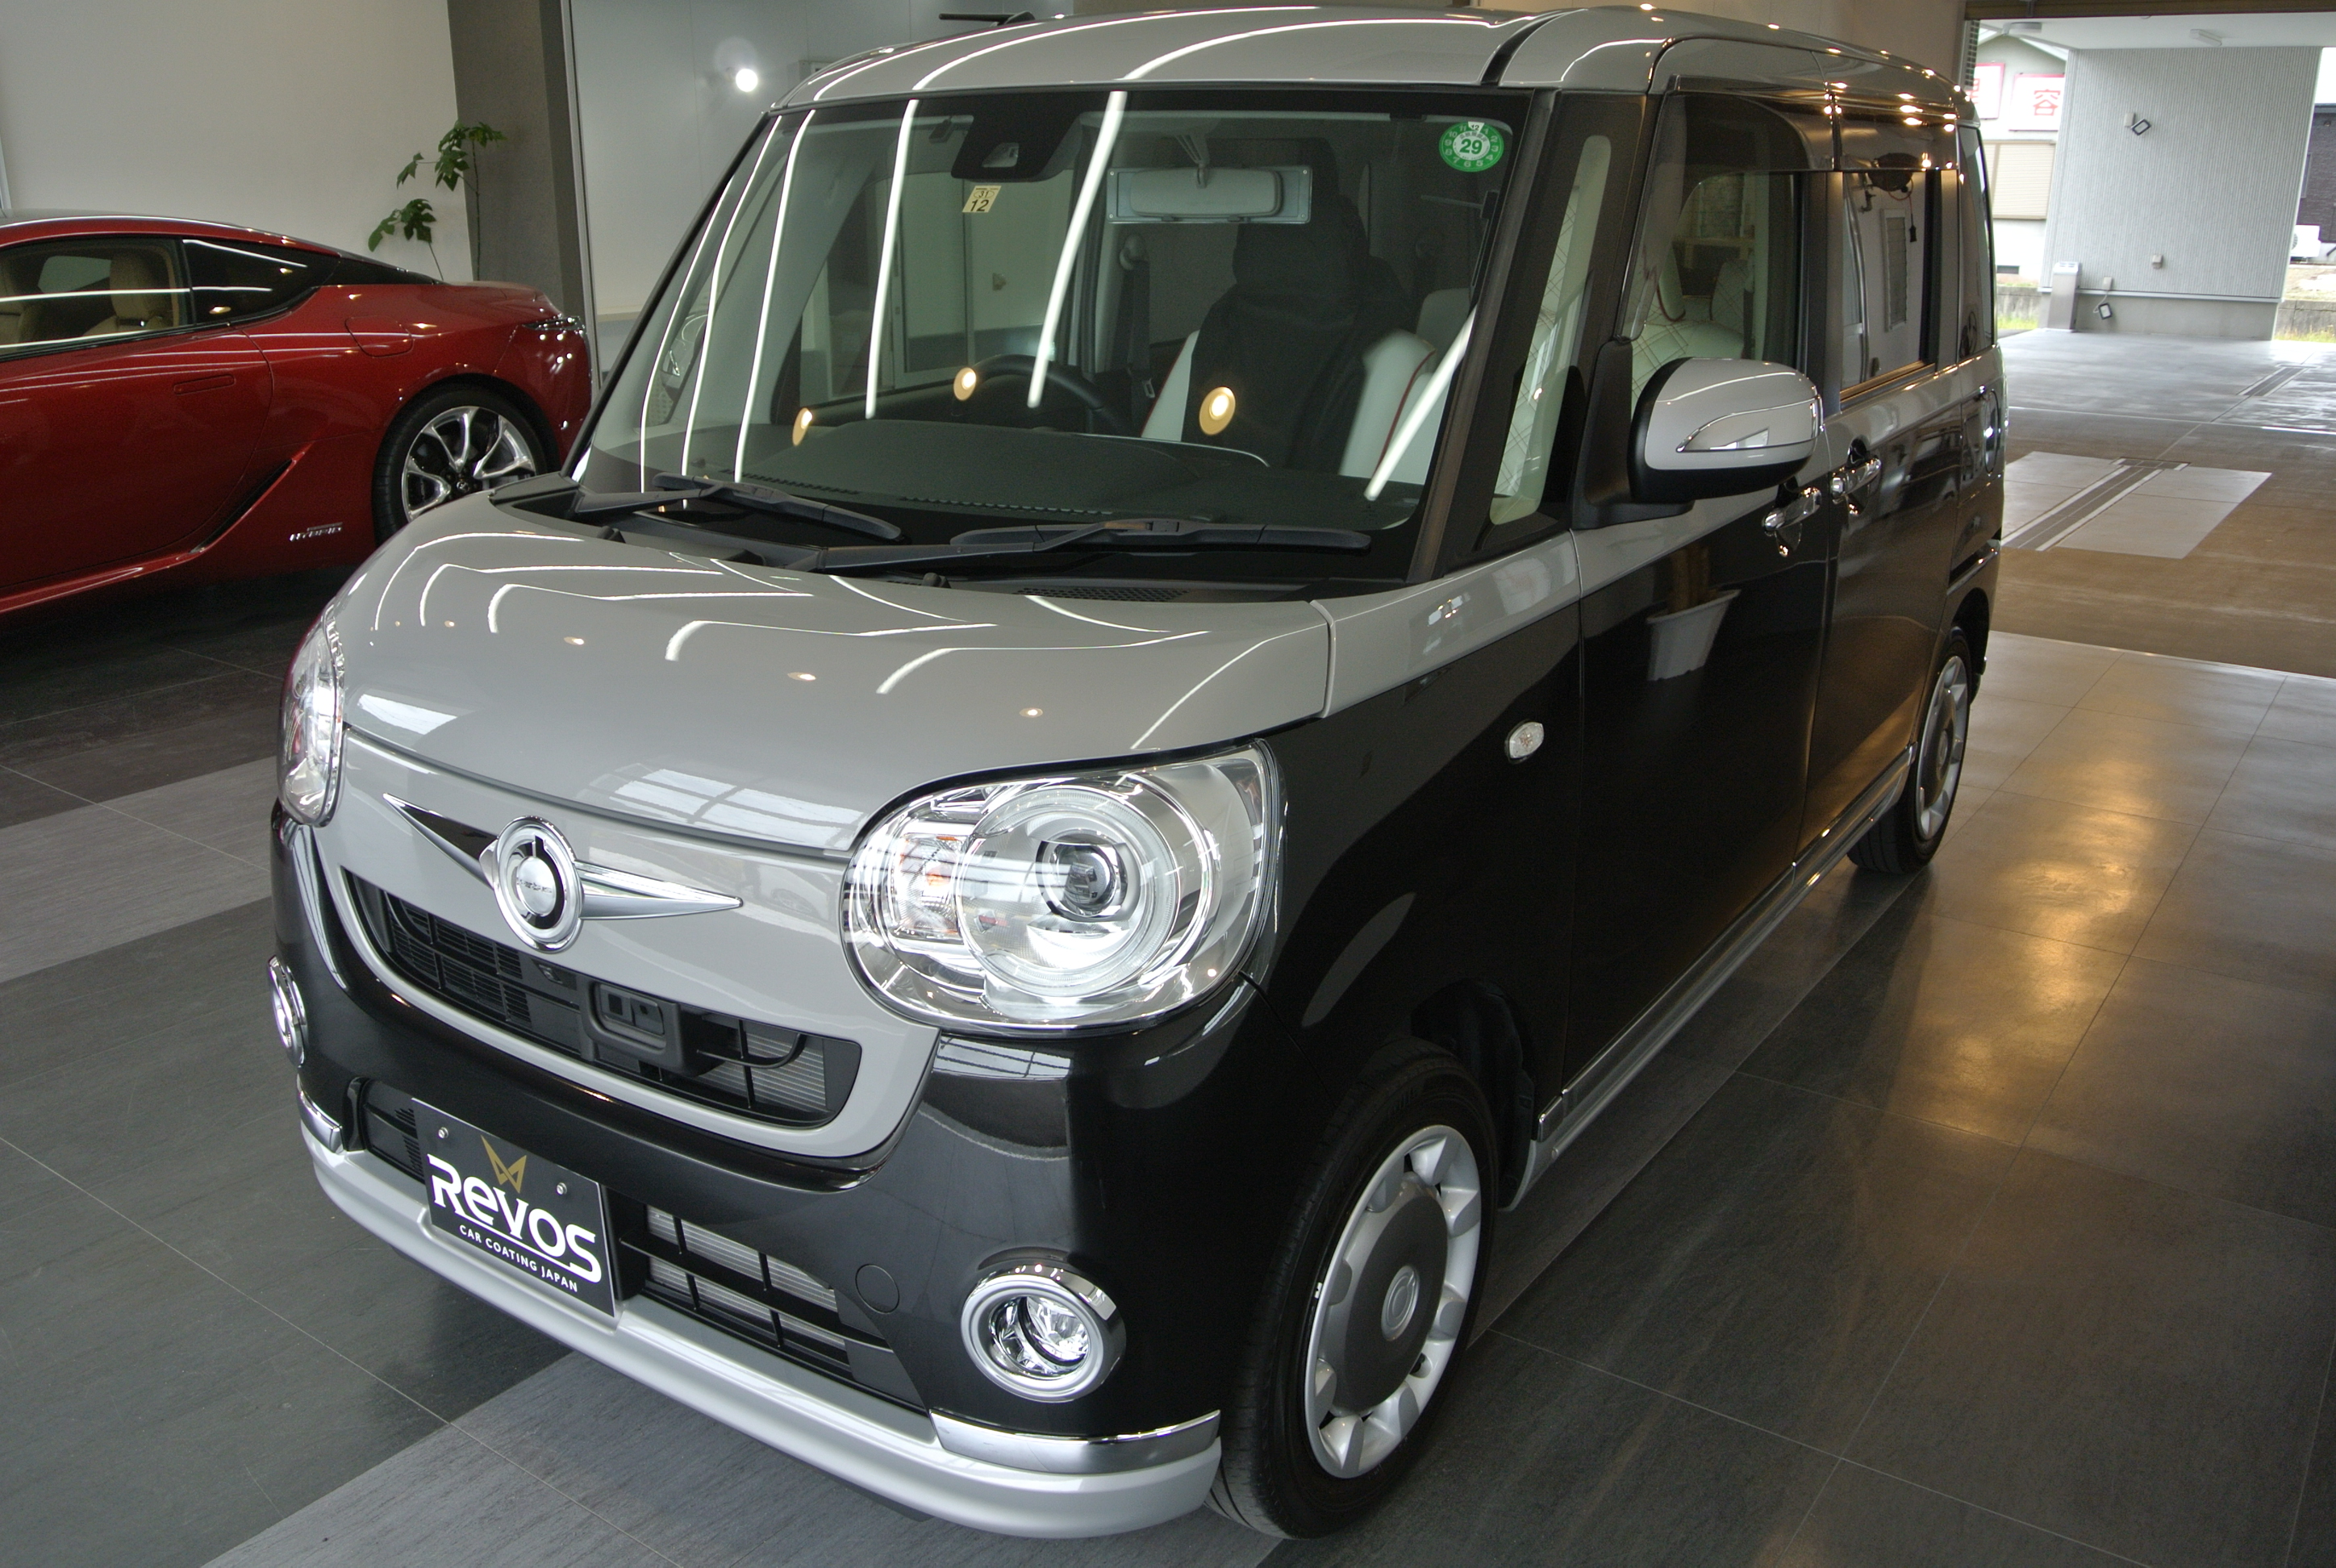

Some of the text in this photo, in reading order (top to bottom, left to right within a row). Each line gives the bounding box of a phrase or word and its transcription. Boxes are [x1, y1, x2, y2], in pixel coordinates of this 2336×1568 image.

[2032, 89, 2062, 116] 容
[1459, 138, 1483, 155] 29
[978, 190, 990, 198] 31
[970, 199, 990, 212] 12
[459, 1224, 578, 1293] CAR COATING JAPAN
